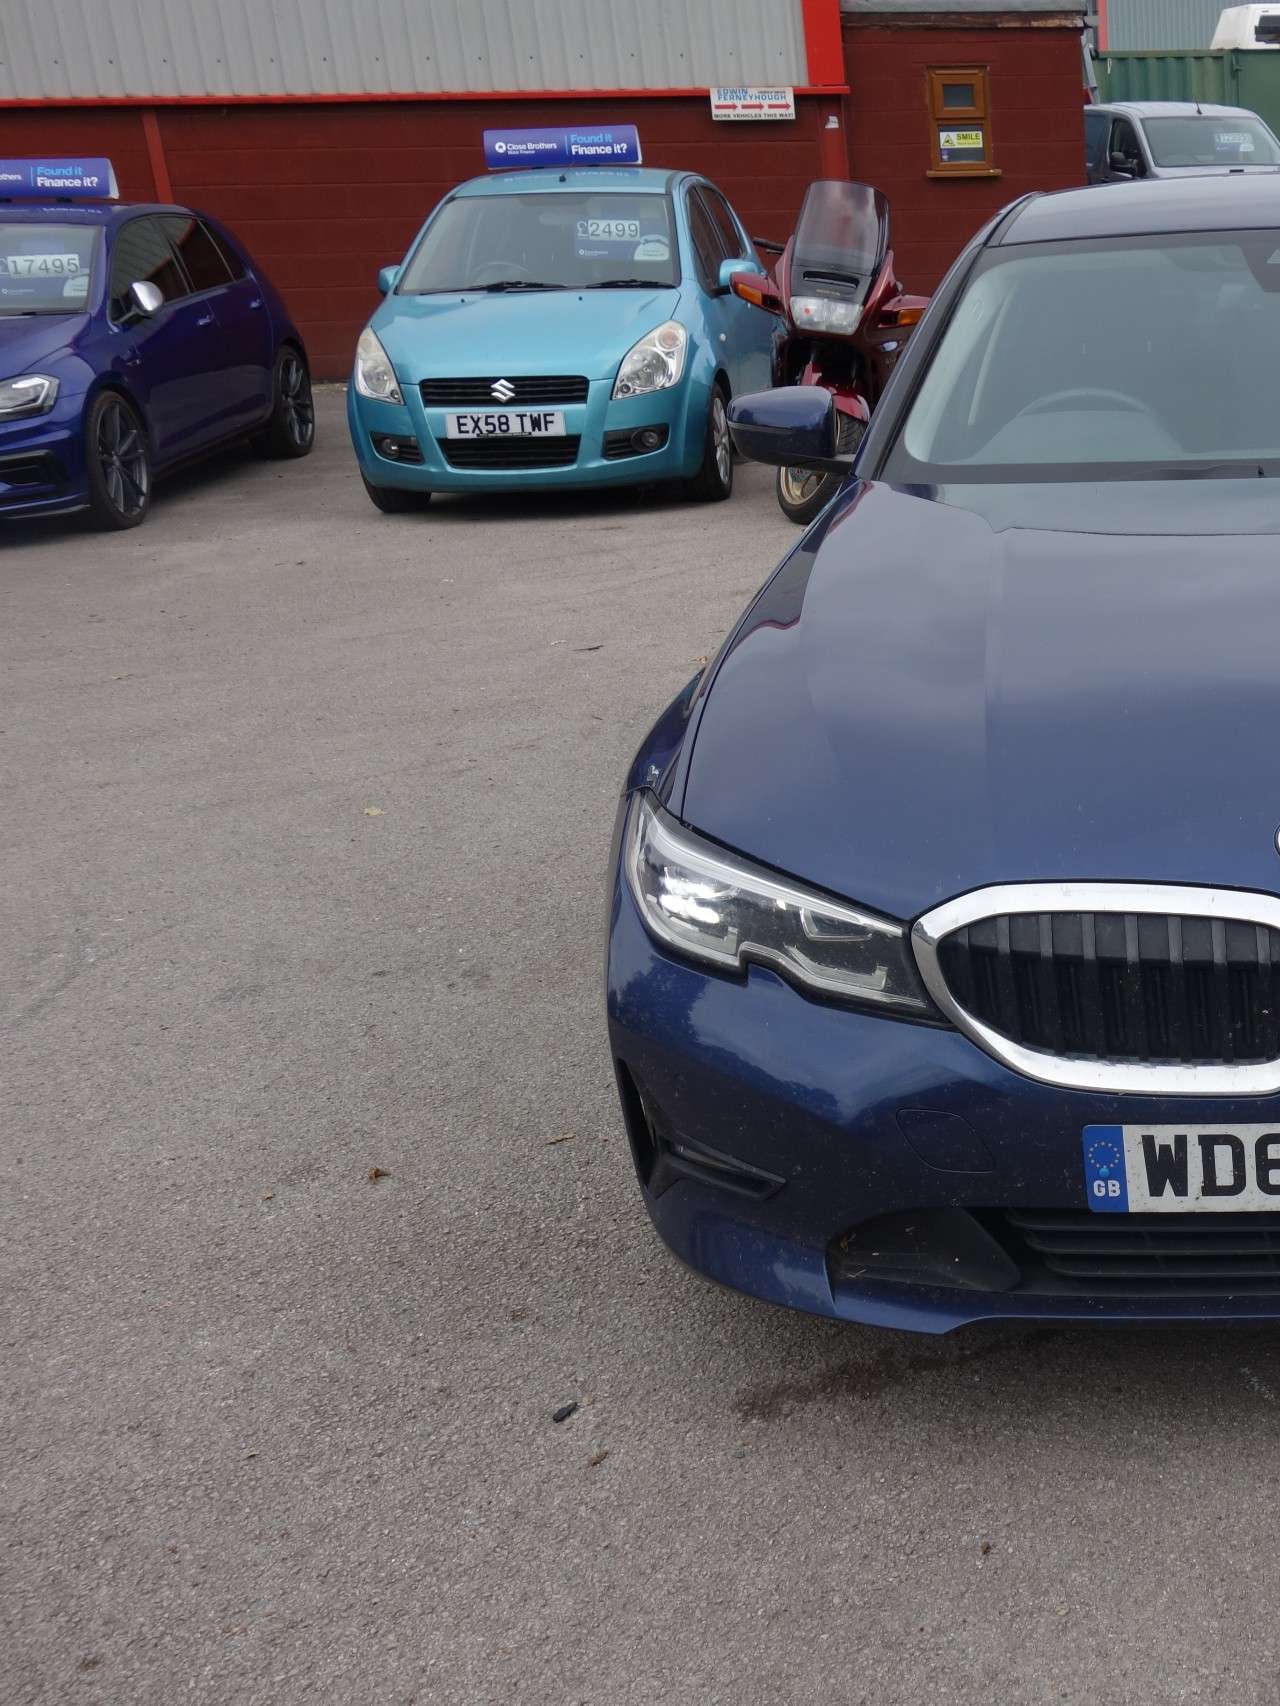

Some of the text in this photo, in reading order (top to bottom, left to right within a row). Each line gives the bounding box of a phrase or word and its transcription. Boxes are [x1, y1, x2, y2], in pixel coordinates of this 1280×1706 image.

[570, 133, 613, 143] Found it
[956, 132, 981, 140] SMILE
[507, 142, 557, 151] Close Brothers
[571, 143, 628, 155] Finance it?
[37, 166, 82, 176] Found it
[37, 176, 98, 187] Finance it?
[577, 221, 638, 238] £2499
[456, 413, 555, 435] EX58 TWF
[1093, 1180, 1121, 1197] GB
